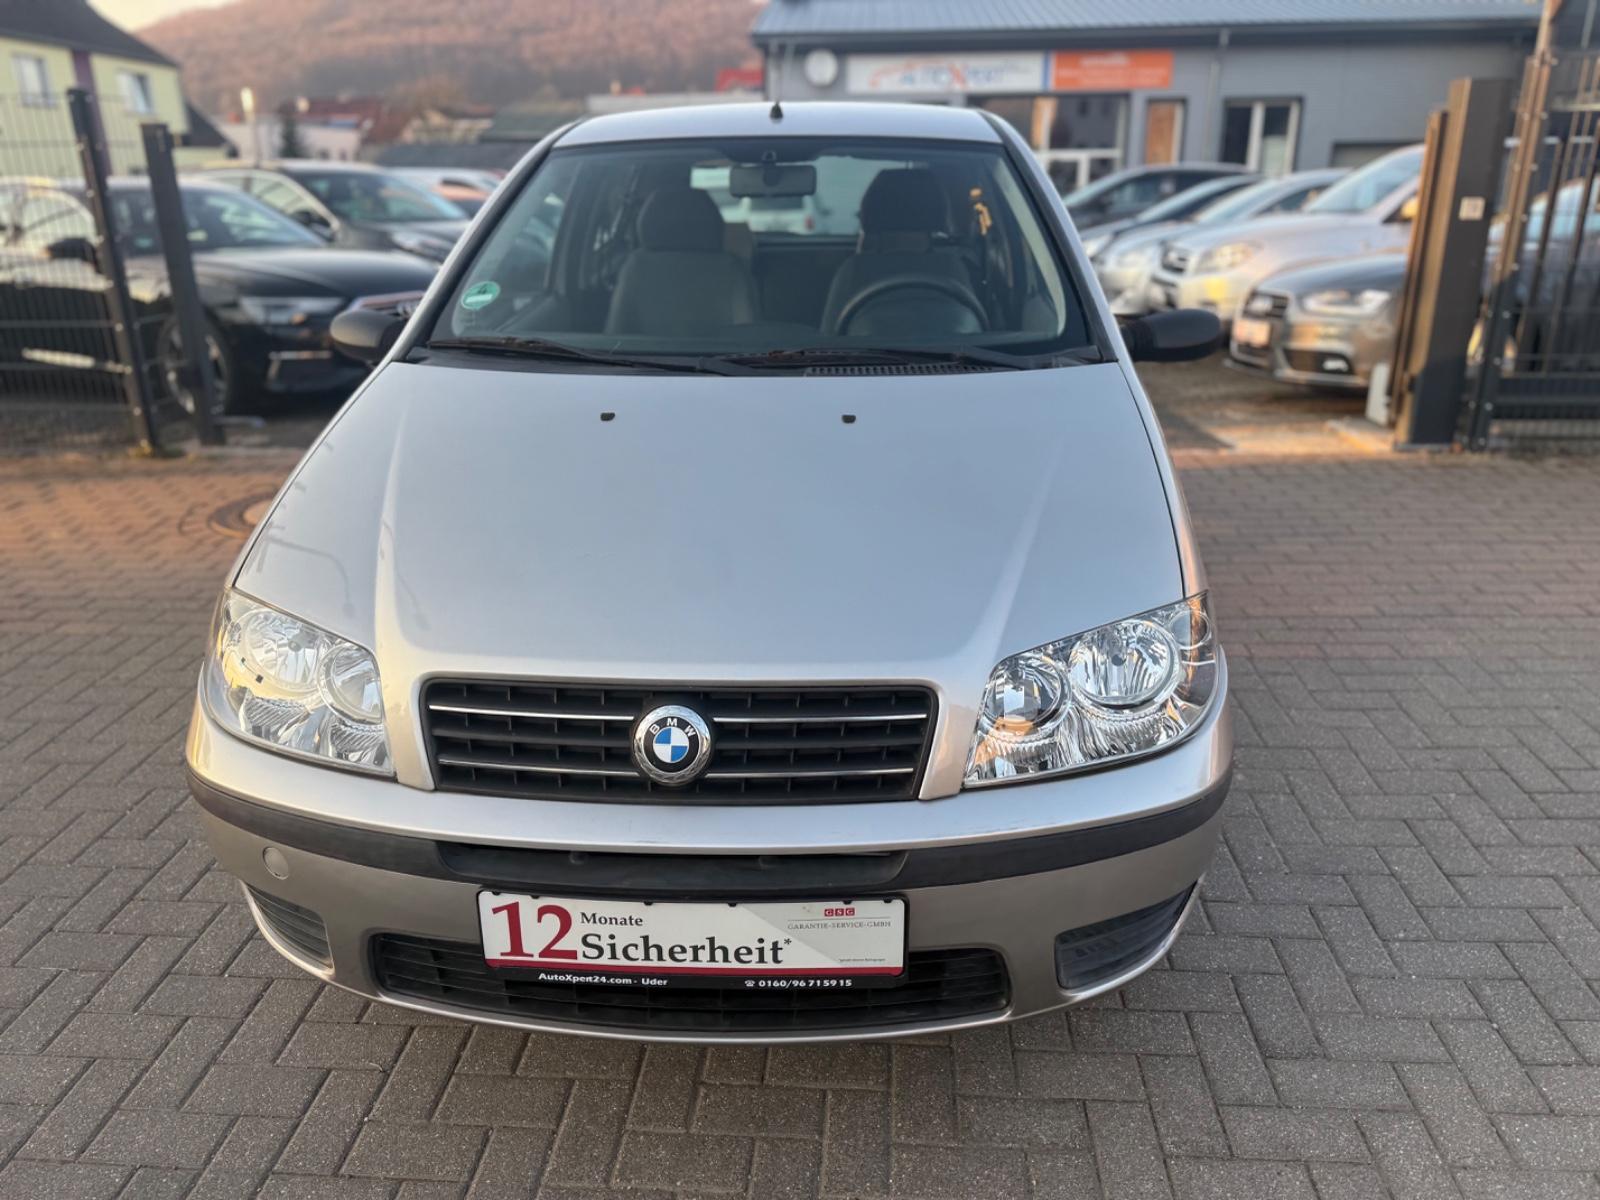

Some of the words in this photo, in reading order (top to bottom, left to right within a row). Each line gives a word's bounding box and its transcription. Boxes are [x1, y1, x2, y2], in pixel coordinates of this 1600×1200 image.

[649, 717, 696, 737] BMW
[580, 912, 644, 926] Monate
[825, 907, 855, 917] GSG
[491, 901, 578, 960] 12
[538, 972, 632, 985] AutoXpert24.com
[641, 977, 668, 987] Uder
